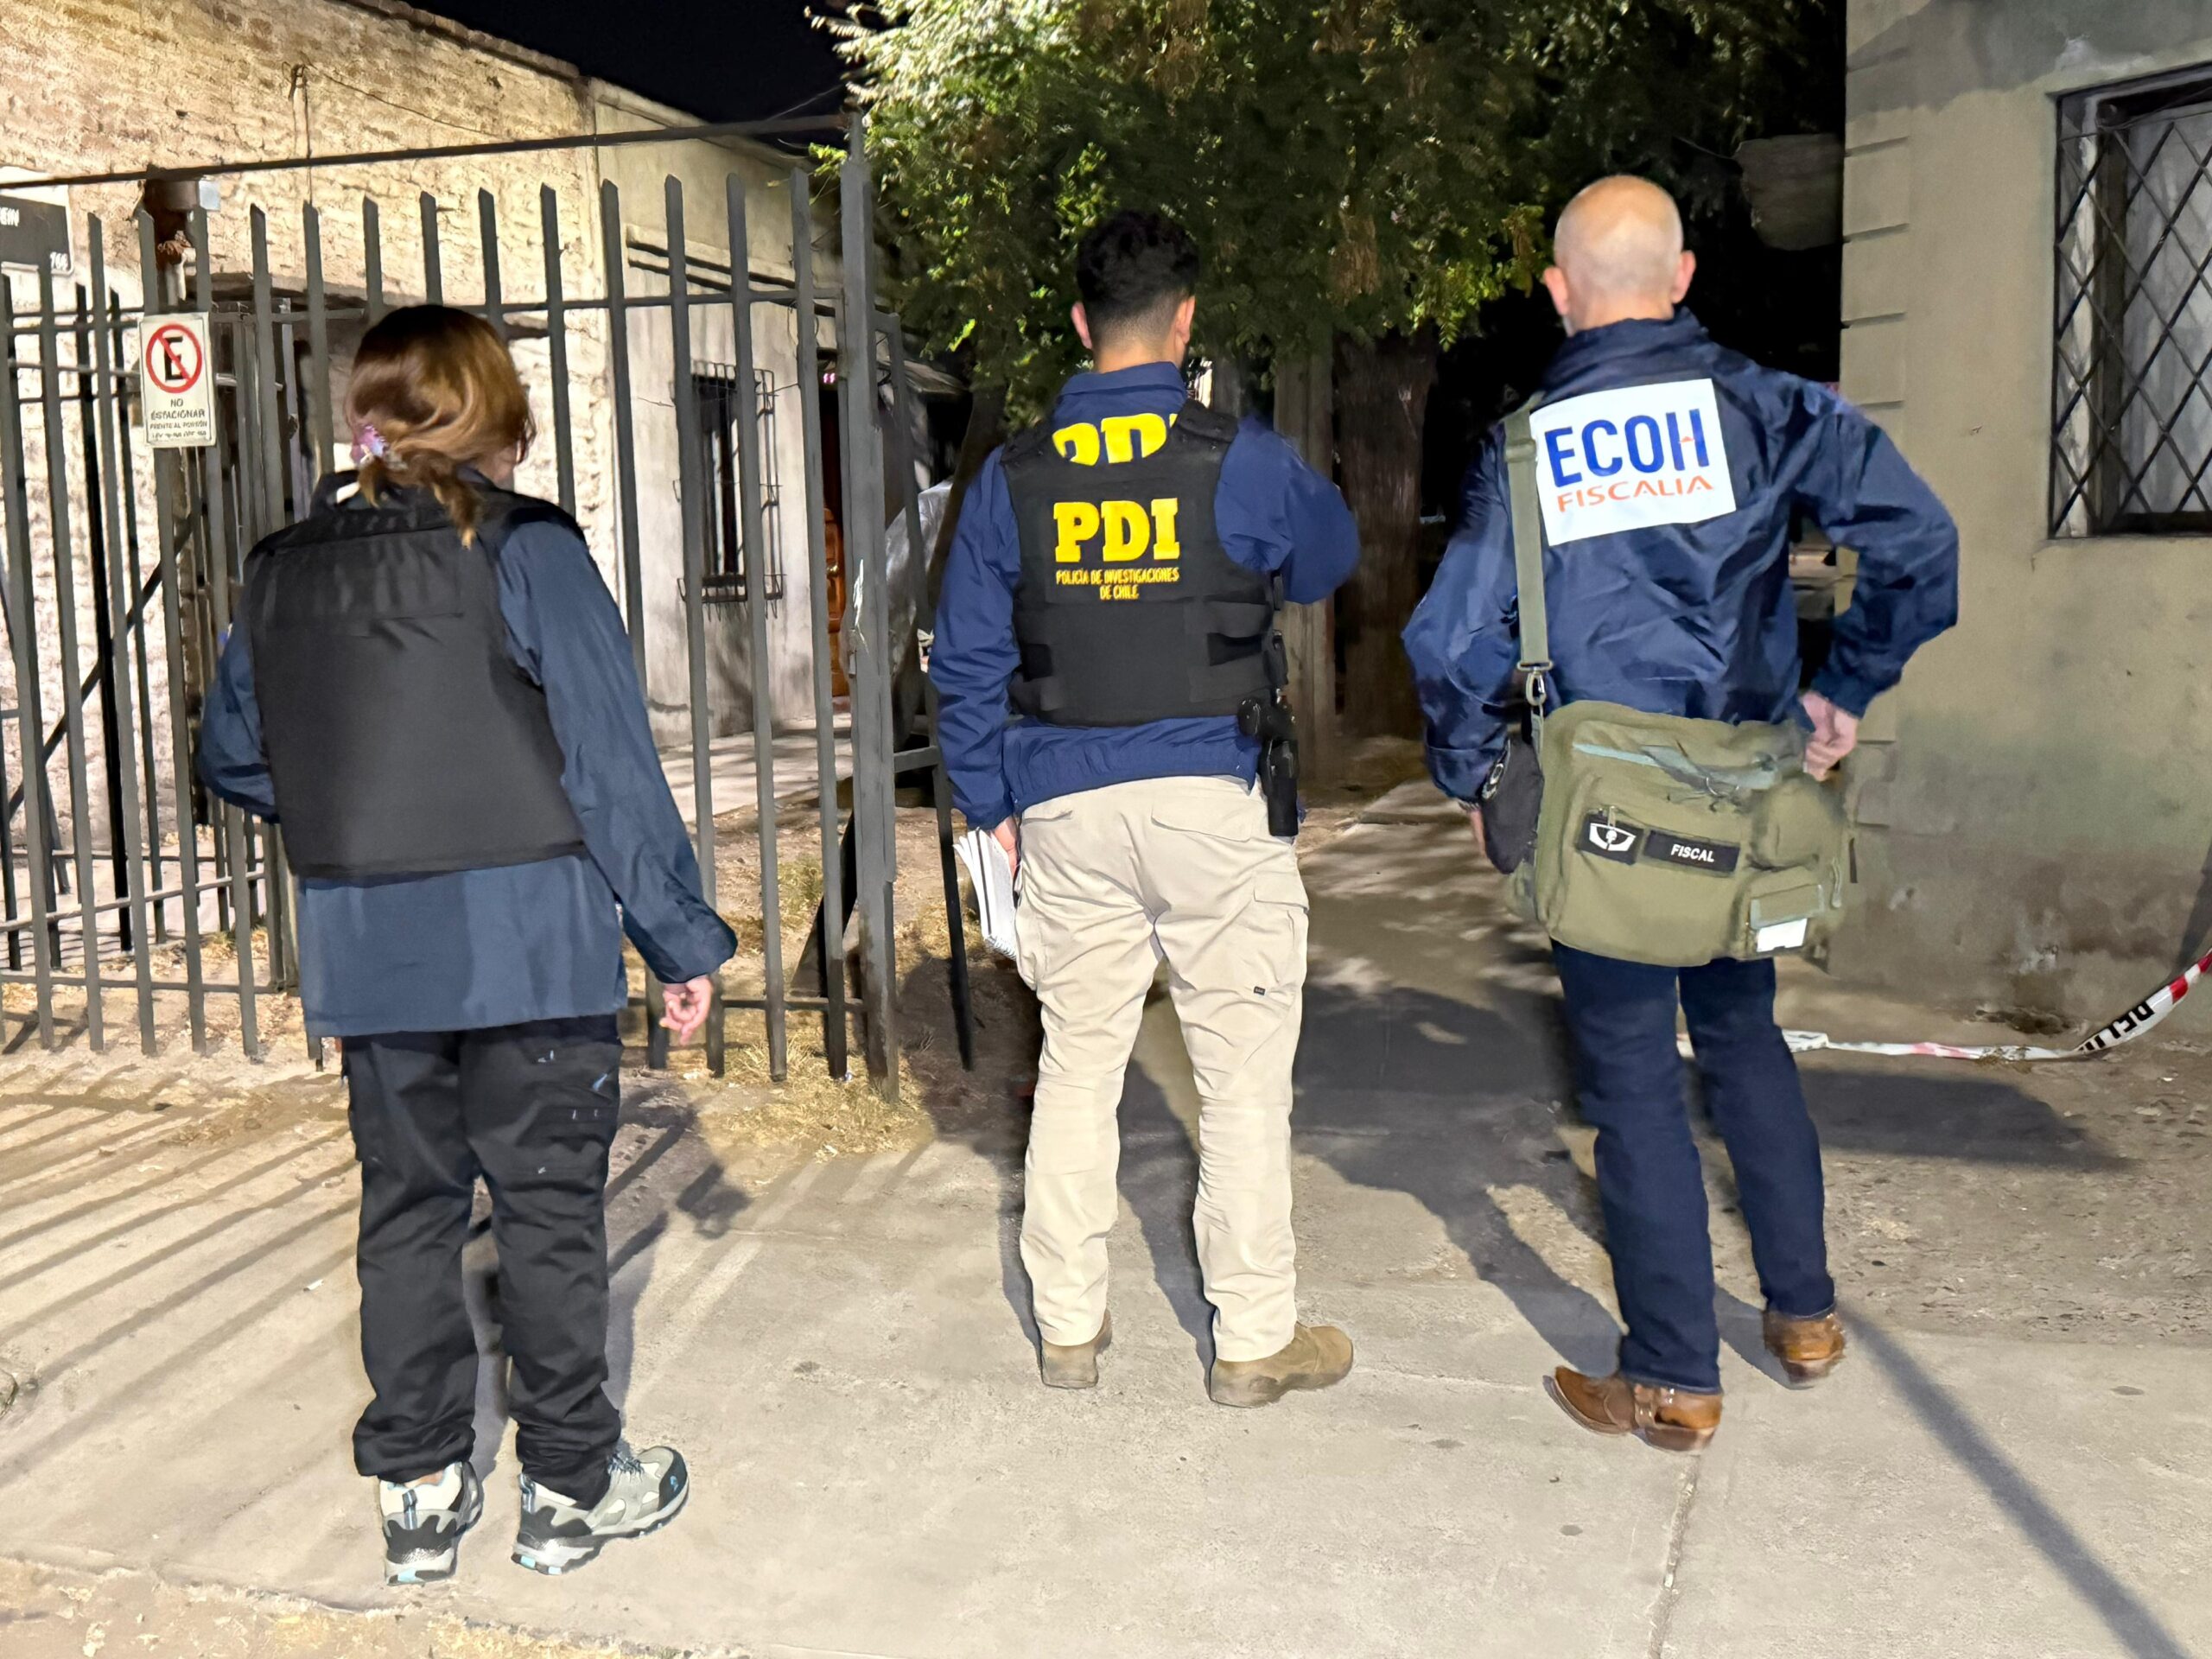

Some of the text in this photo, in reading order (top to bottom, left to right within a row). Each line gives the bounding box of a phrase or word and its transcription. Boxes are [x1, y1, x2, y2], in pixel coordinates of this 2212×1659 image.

[170, 397, 184, 408] NO
[150, 408, 206, 420] ESTACIONAR
[1557, 474, 1713, 512] FISCALIA
[1053, 497, 1180, 563] PDI
[1090, 569, 1103, 585] DE
[1103, 567, 1180, 584] INVESTIGACIONES
[1099, 584, 1140, 601] DE CHILE
[1670, 843, 1714, 862] FISCAL
